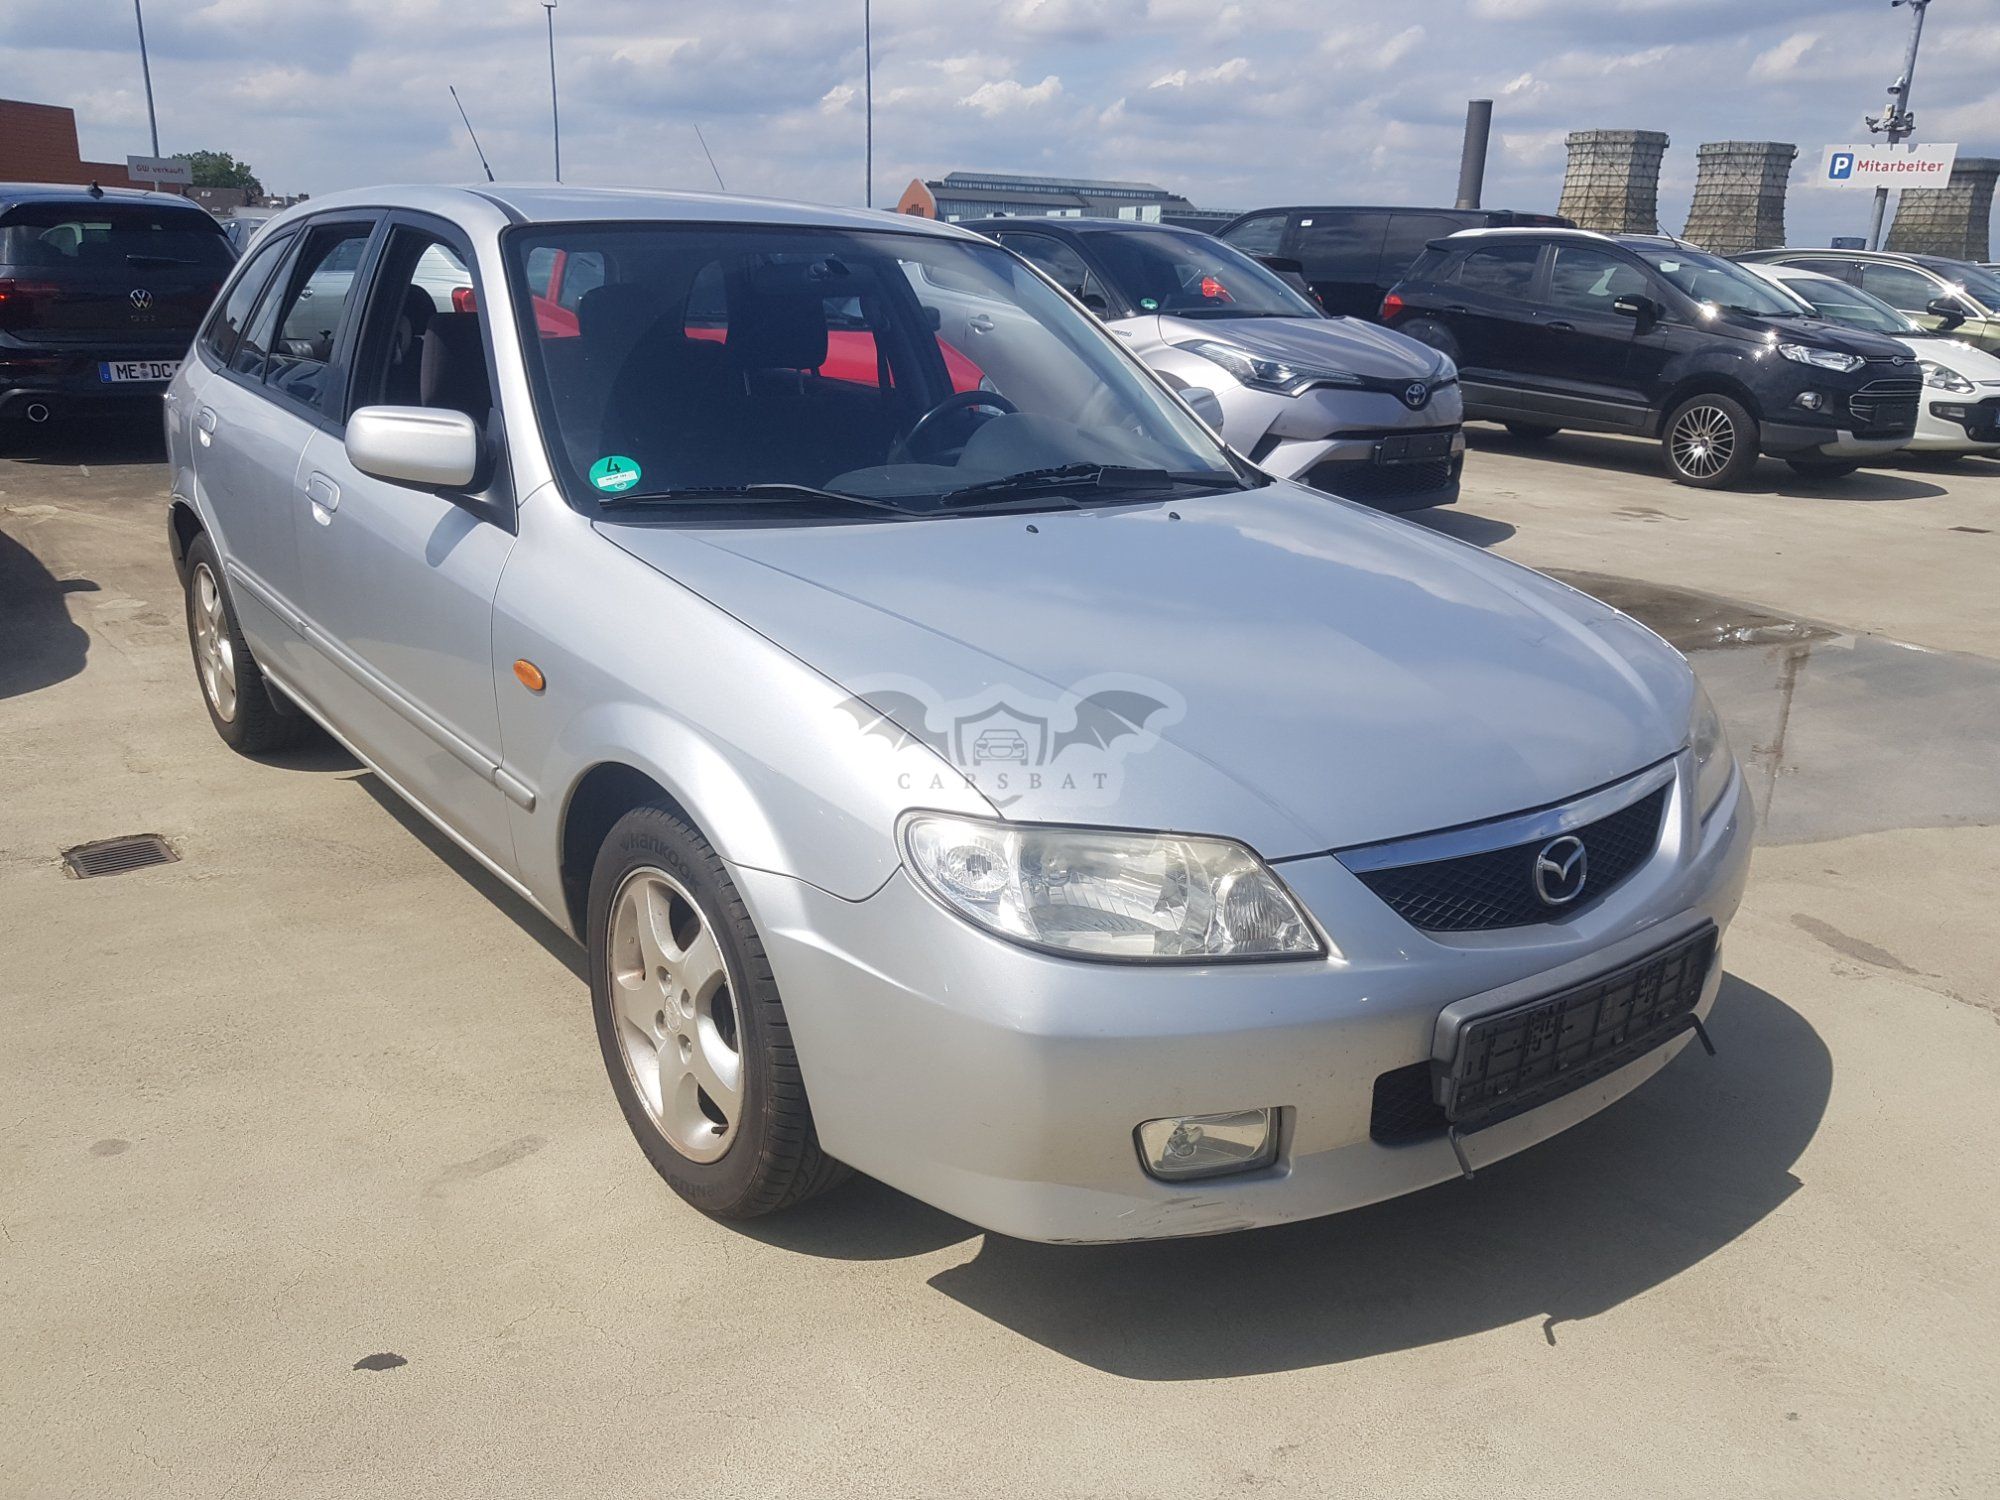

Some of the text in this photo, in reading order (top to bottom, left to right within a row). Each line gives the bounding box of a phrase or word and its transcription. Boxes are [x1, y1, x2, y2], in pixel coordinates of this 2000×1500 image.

[1833, 156, 1944, 176] P Mitarbeiter
[116, 364, 139, 379] ME
[149, 363, 172, 378] DC
[607, 457, 621, 473] 4
